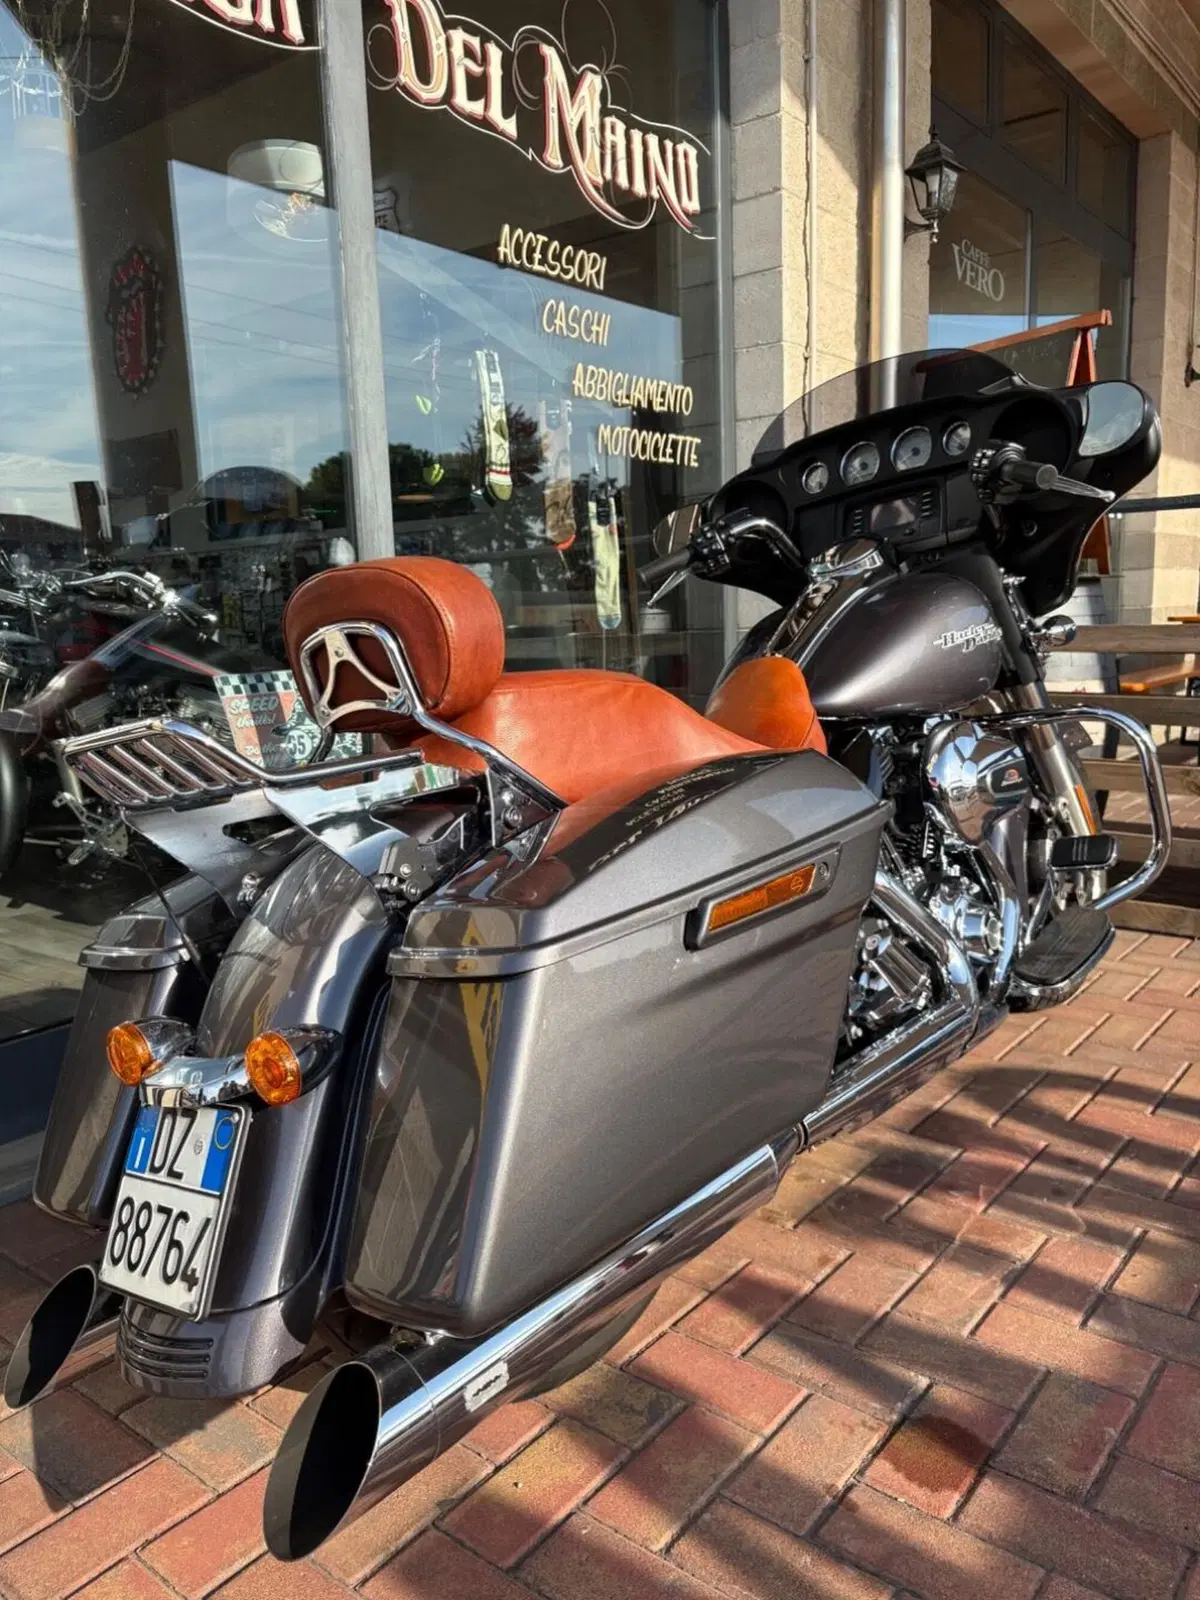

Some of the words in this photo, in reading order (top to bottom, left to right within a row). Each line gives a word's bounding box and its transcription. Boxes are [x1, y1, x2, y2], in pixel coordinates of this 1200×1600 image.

[384, 0, 517, 139] DEL
[538, 43, 700, 228] MAINO
[498, 223, 607, 290] ACCESSORI
[952, 243, 1005, 301] VERO
[541, 298, 611, 346] CASCHI
[572, 362, 694, 416] ABBIGLIAMENTO
[598, 423, 701, 468] MOTOCICLETTE
[149, 1107, 198, 1180] DZ
[109, 1196, 213, 1292] 88764
